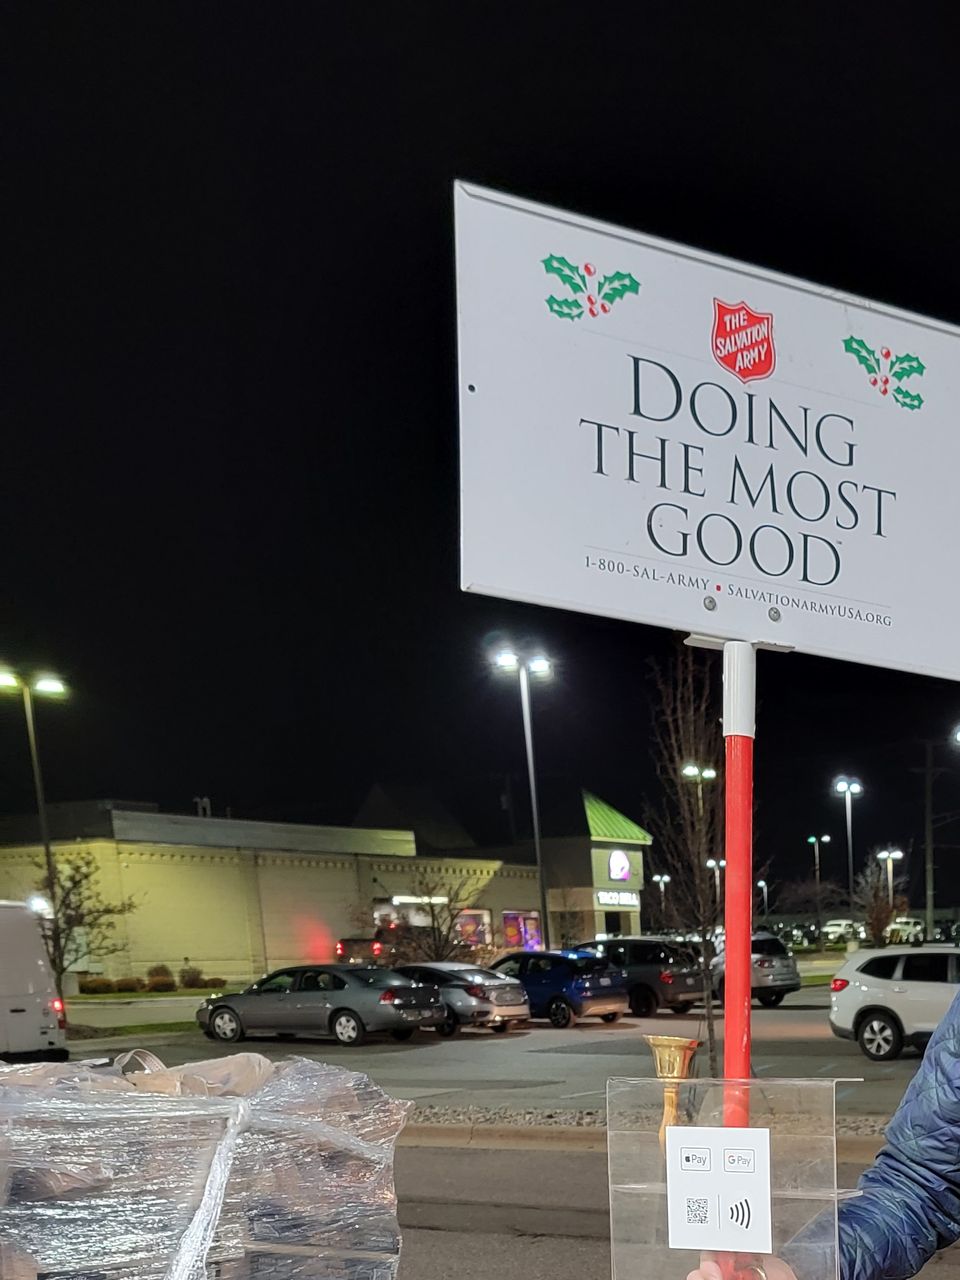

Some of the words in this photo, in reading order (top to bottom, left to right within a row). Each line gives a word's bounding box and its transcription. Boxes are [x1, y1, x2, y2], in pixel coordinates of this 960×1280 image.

[723, 310, 749, 331] THE
[715, 320, 769, 360] SALVATION
[735, 342, 768, 372] ARMY
[627, 354, 858, 467] DOING
[579, 418, 707, 498] THE
[728, 453, 897, 538] MOST
[646, 502, 842, 586] GOOD
[584, 555, 711, 591] 1-800-SAL-ARMY
[692, 1153, 707, 1166] Pay
[728, 1154, 736, 1165] G
[737, 1156, 751, 1168] Pay
